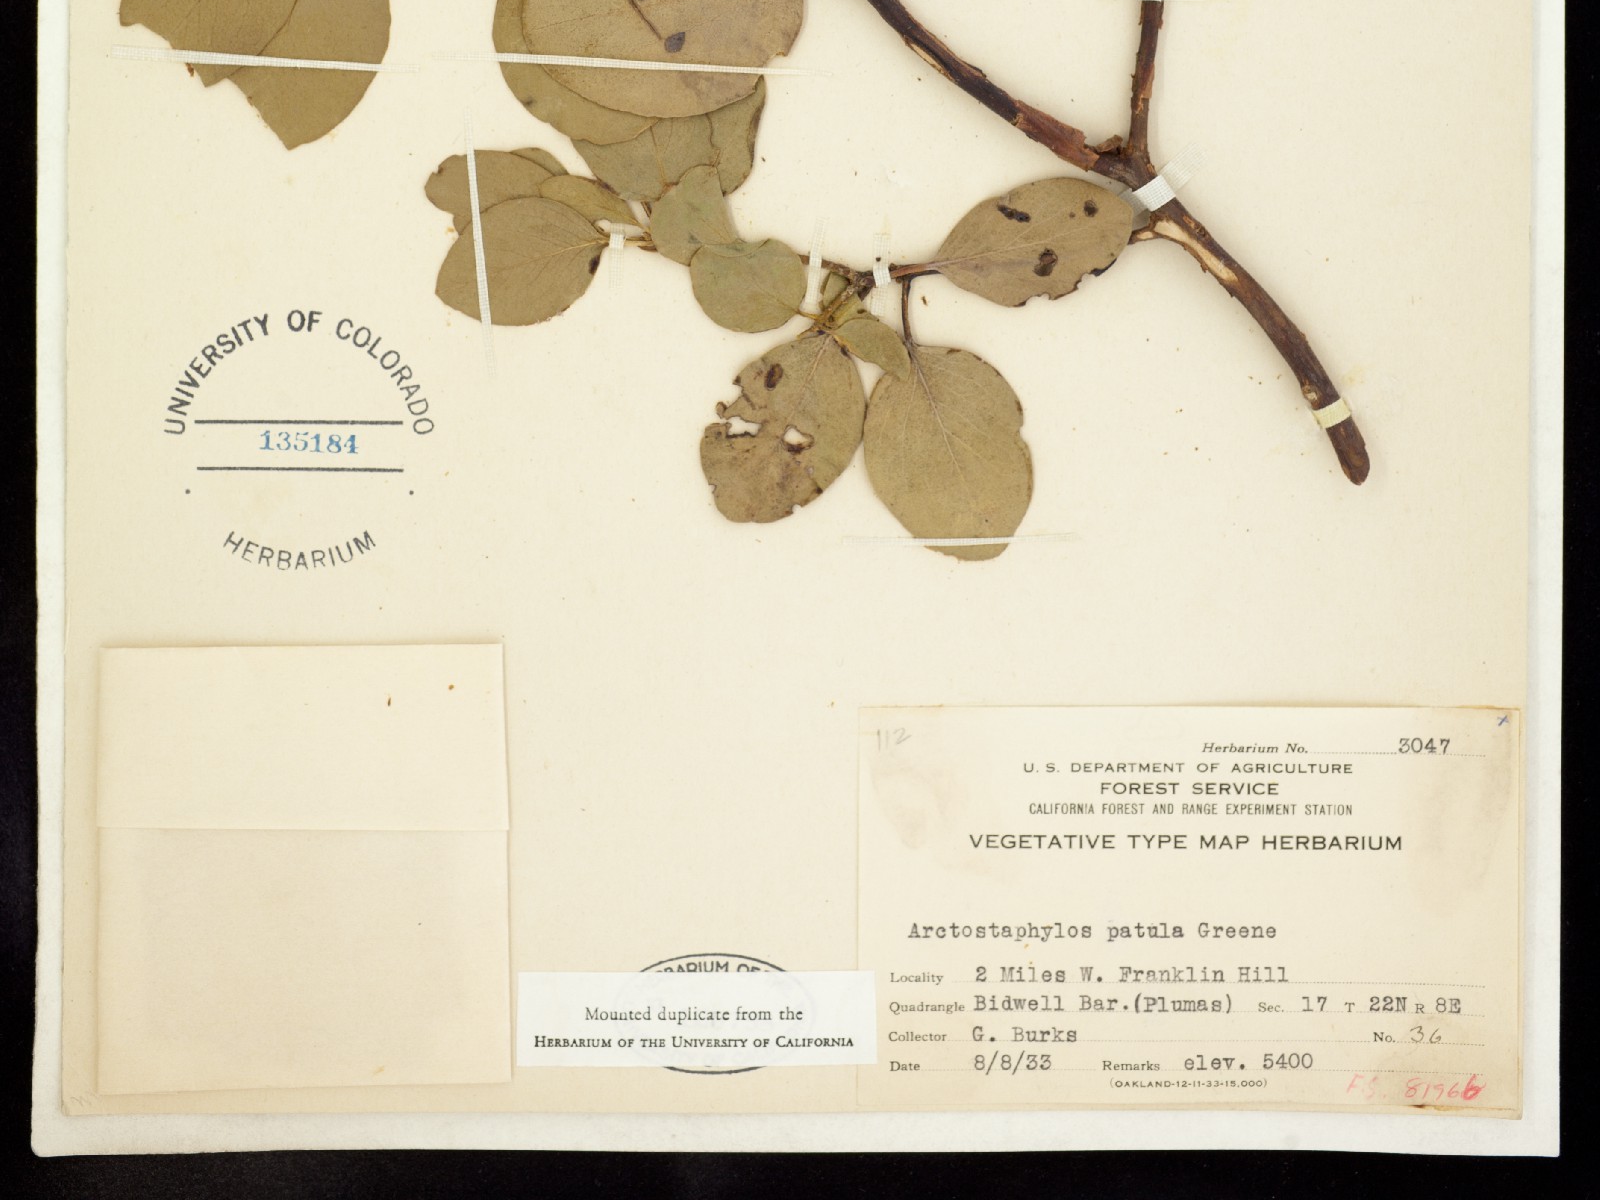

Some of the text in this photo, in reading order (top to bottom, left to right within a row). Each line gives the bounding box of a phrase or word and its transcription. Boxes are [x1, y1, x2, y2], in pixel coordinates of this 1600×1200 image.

[163, 309, 435, 436] UNIVERSITY OF COLORADO
[259, 430, 360, 455] 135184
[222, 530, 376, 571] HERBARIUM
[1201, 737, 1451, 755] Herbarium No. 3047
[1023, 762, 1353, 775] U. S. DEPARTMENT OF AGRICULTURE
[1100, 782, 1280, 796] FOREST SERVICE
[1029, 803, 1353, 816] CALIFORNIA FOREST AND RANGE EXPERIMENT STATION
[969, 834, 1403, 851] VEGETATIVE TYPE MAP HERBARIUM
[908, 922, 1277, 942] Arctostaphylos patula Greene
[889, 966, 1290, 986] Locality 2 Miles W. Franklin Hill
[889, 1001, 965, 1015] Quadrangle
[973, 995, 1065, 1012] Bidwell
[1258, 1001, 1285, 1013] Sec.
[1301, 996, 1328, 1012] 17
[1344, 1001, 1356, 1013] T
[1368, 996, 1408, 1013] 22N
[1415, 1002, 1426, 1014] R
[1435, 997, 1462, 1014] 8E
[584, 1006, 804, 1025] Mounted duplicate from the
[888, 1026, 1396, 1043] Collector G. Burks No.
[1409, 1025, 1443, 1044] 36
[889, 1050, 1314, 1076] Date 8/8/33 Remarks elev. 5400
